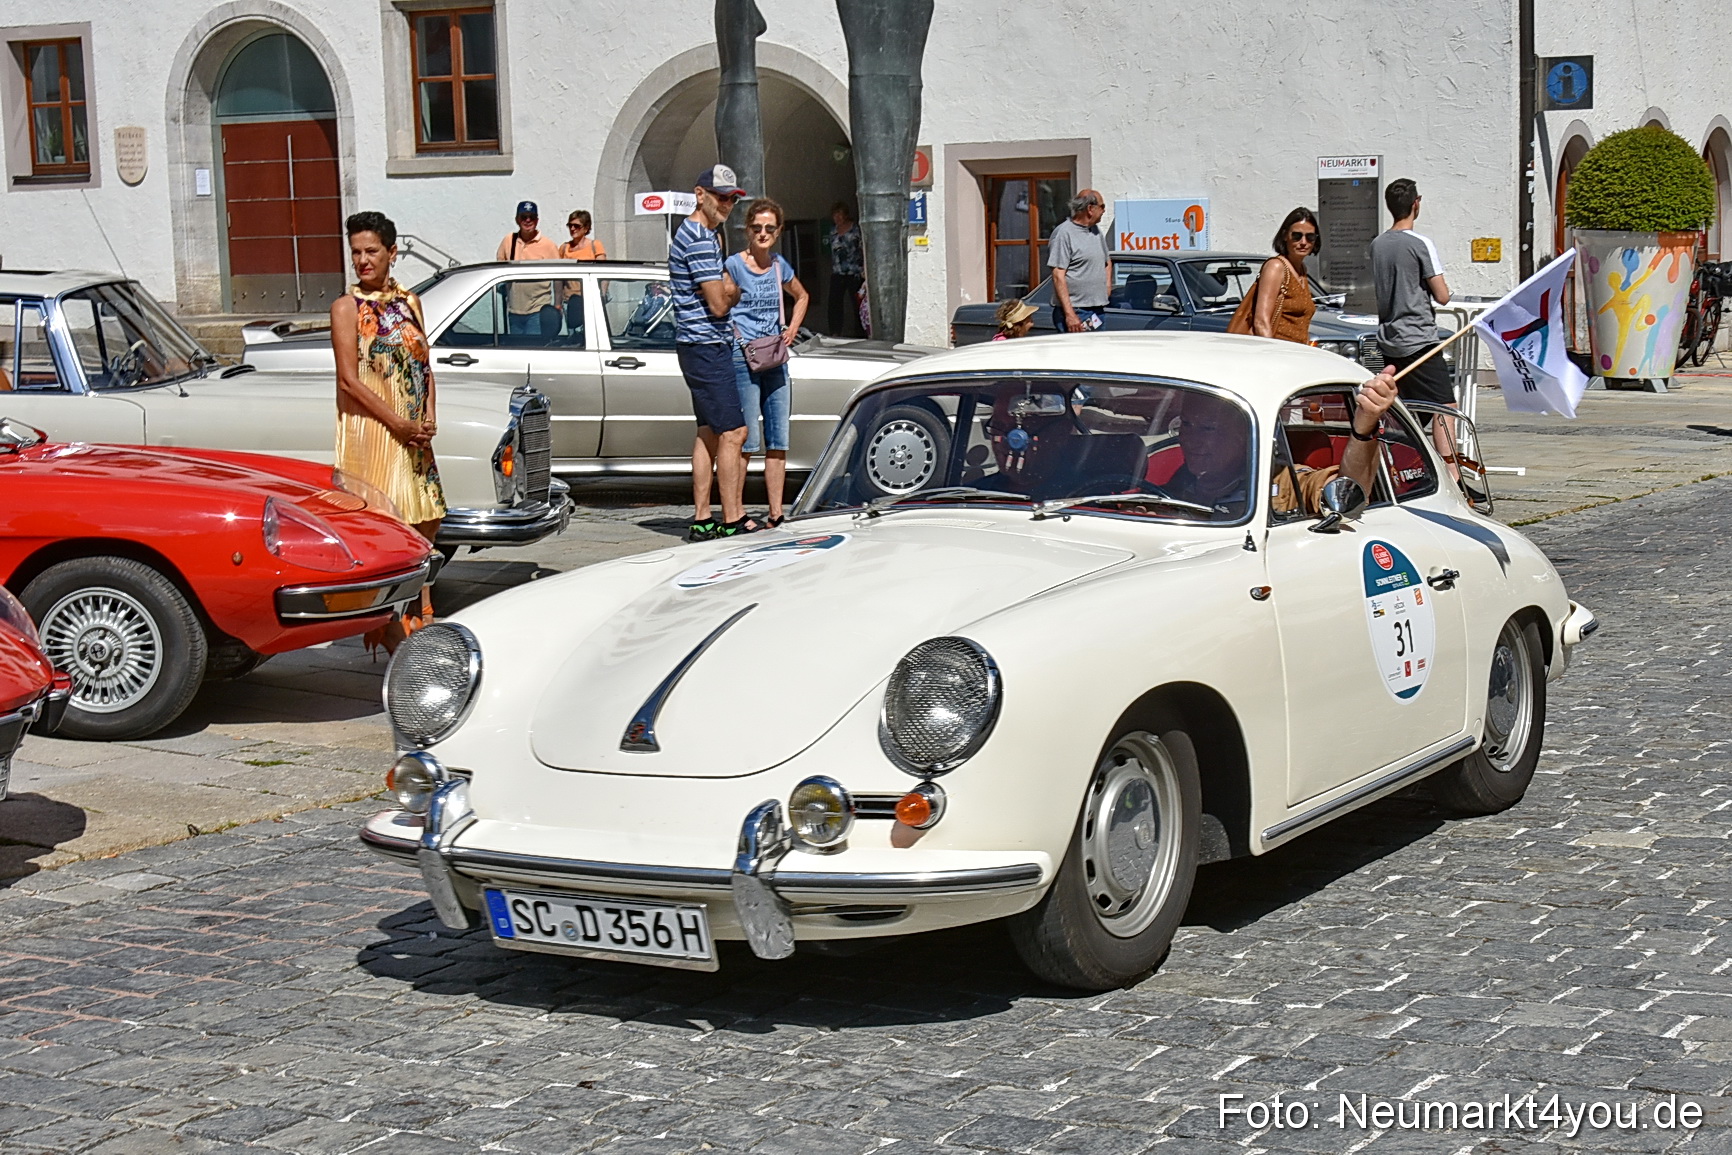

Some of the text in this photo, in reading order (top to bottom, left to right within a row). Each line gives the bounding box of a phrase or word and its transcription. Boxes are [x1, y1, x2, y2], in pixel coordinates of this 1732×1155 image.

[1320, 159, 1368, 168] NEUMARKT
[1120, 231, 1180, 251] Kunst
[1393, 618, 1414, 657] 31
[511, 898, 557, 937] SC
